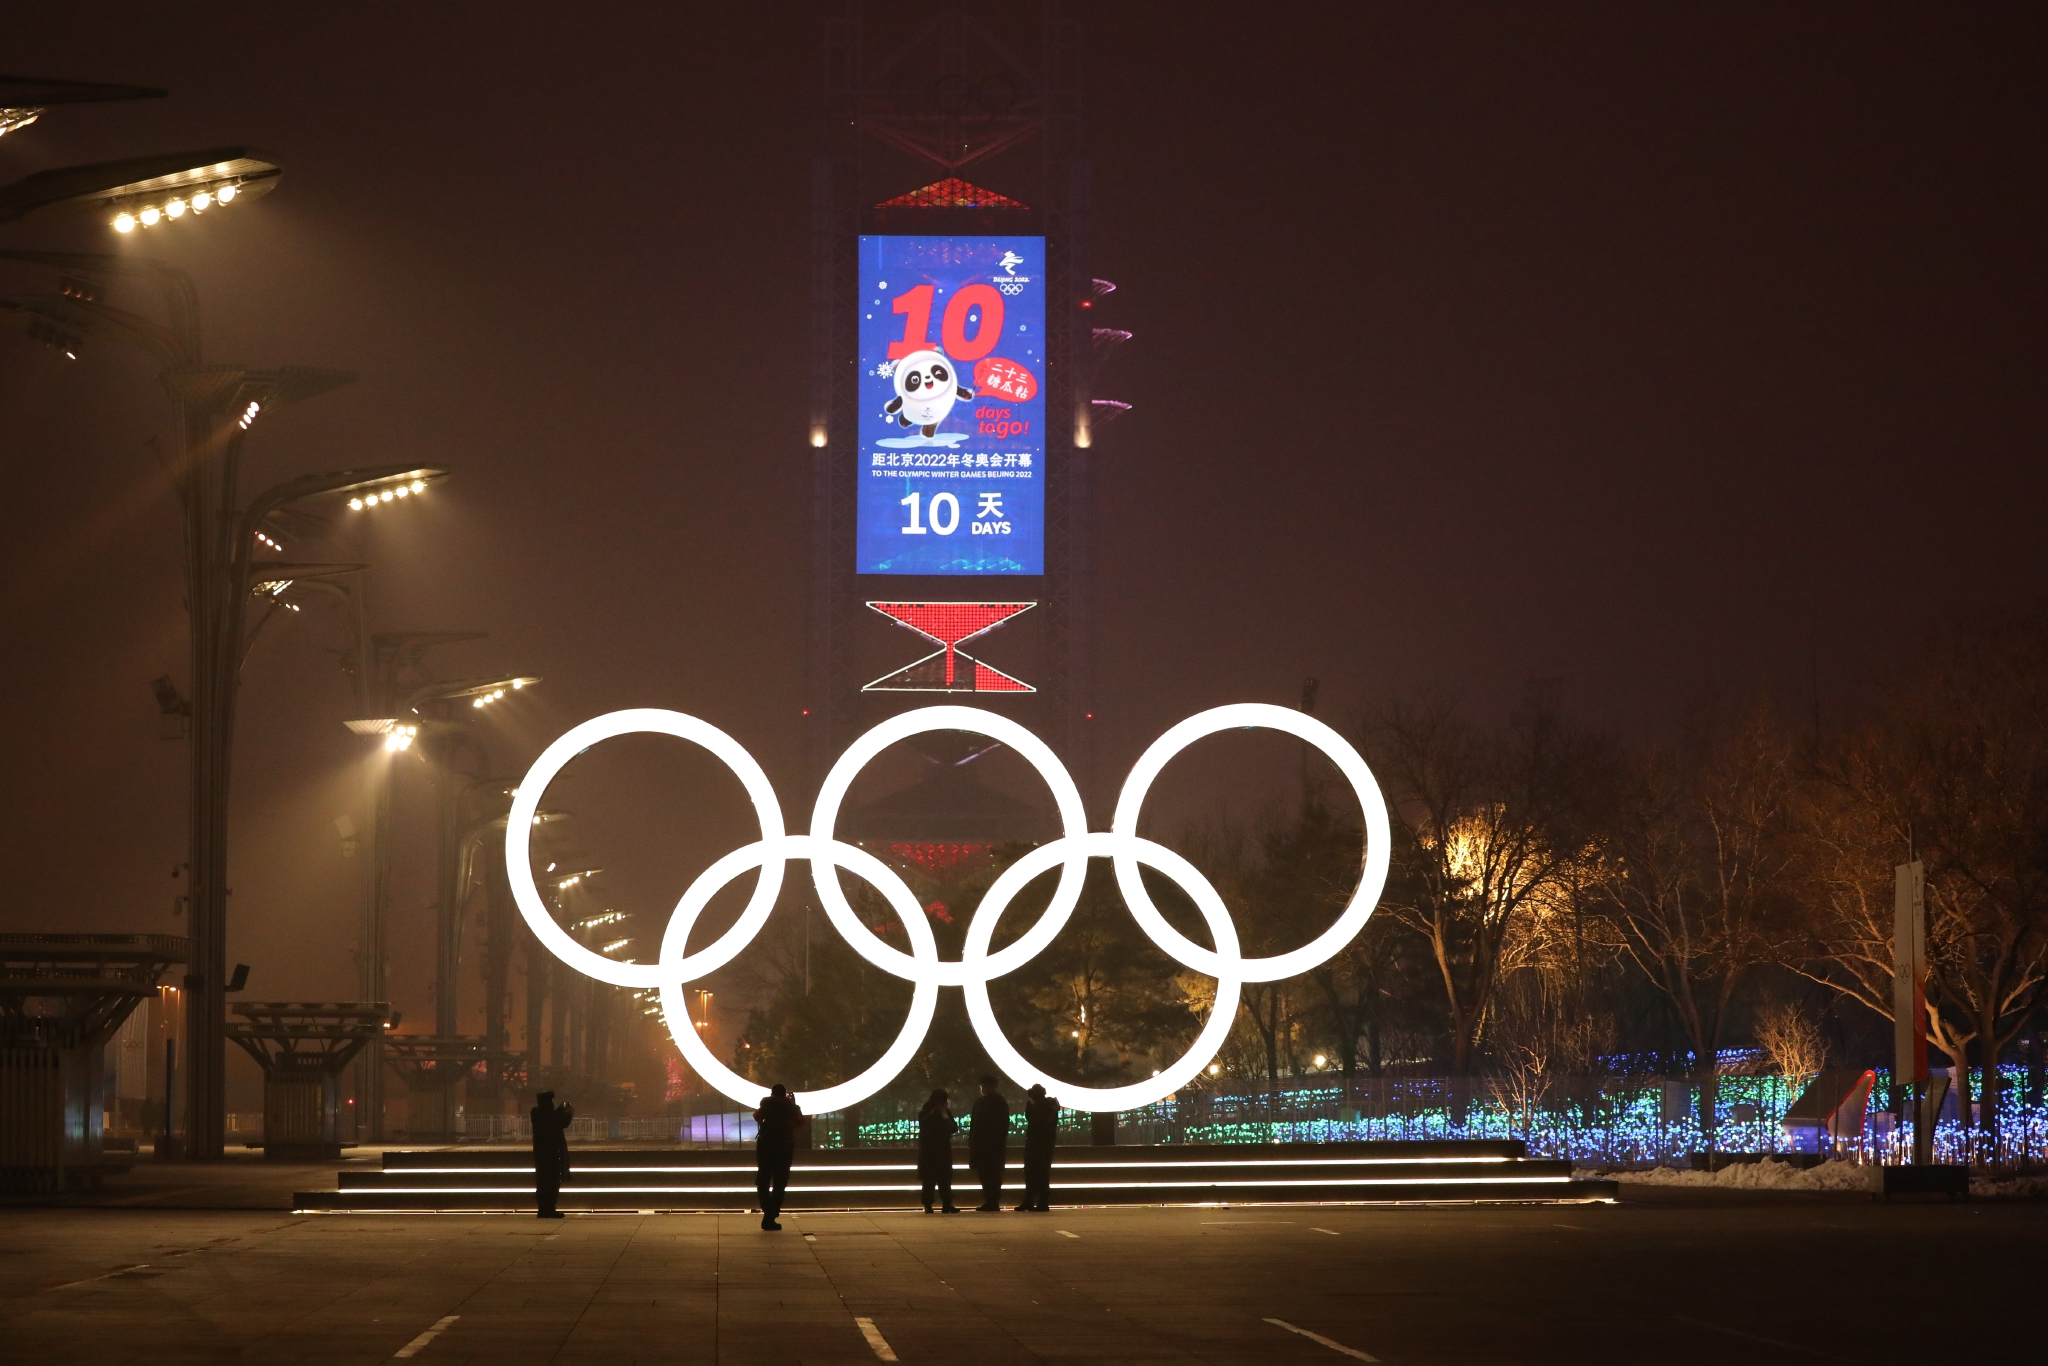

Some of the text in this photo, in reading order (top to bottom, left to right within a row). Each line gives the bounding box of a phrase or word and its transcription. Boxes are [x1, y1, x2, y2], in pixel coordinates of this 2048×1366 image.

[887, 284, 1005, 361] 10
[991, 363, 1028, 384] 二十三
[986, 373, 1029, 399] 糖瓜粘
[975, 405, 1011, 422] days
[872, 452, 1032, 468] 距北京2022年冬奥会开幕
[898, 470, 930, 478] OLYMPIC
[901, 492, 1004, 536] 10 天
[971, 521, 1012, 535] DAYS
